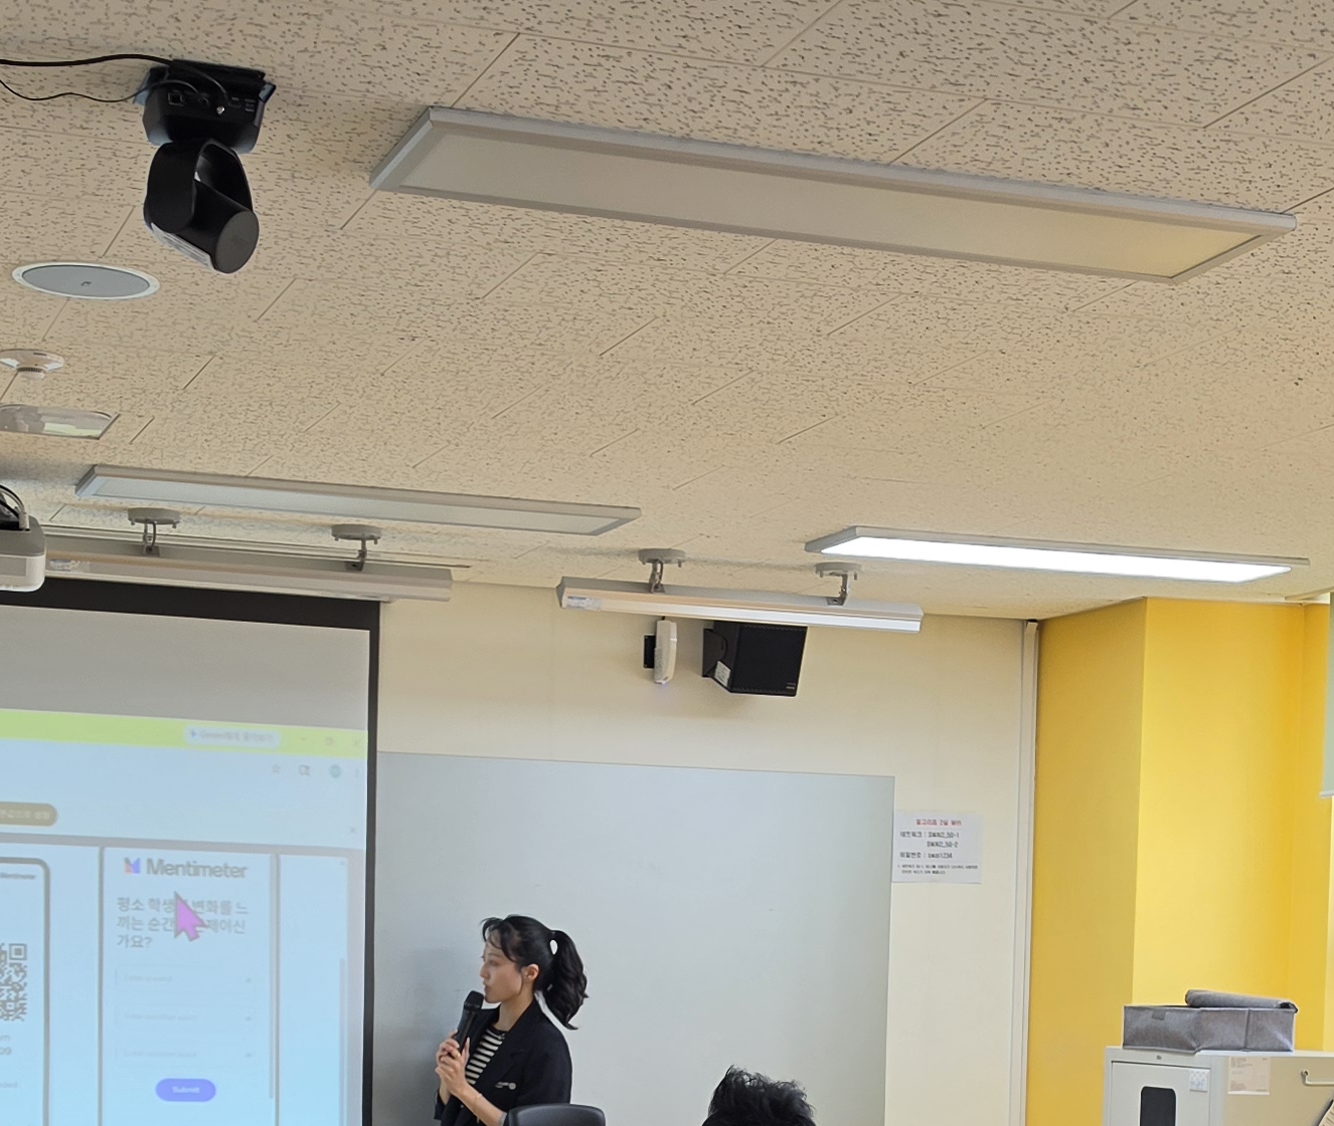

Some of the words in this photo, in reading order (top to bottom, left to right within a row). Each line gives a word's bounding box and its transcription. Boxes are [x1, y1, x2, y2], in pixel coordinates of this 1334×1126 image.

[146, 858, 248, 878] Mentimeter
[117, 897, 144, 912] 평소
[117, 934, 153, 949] 가요?
